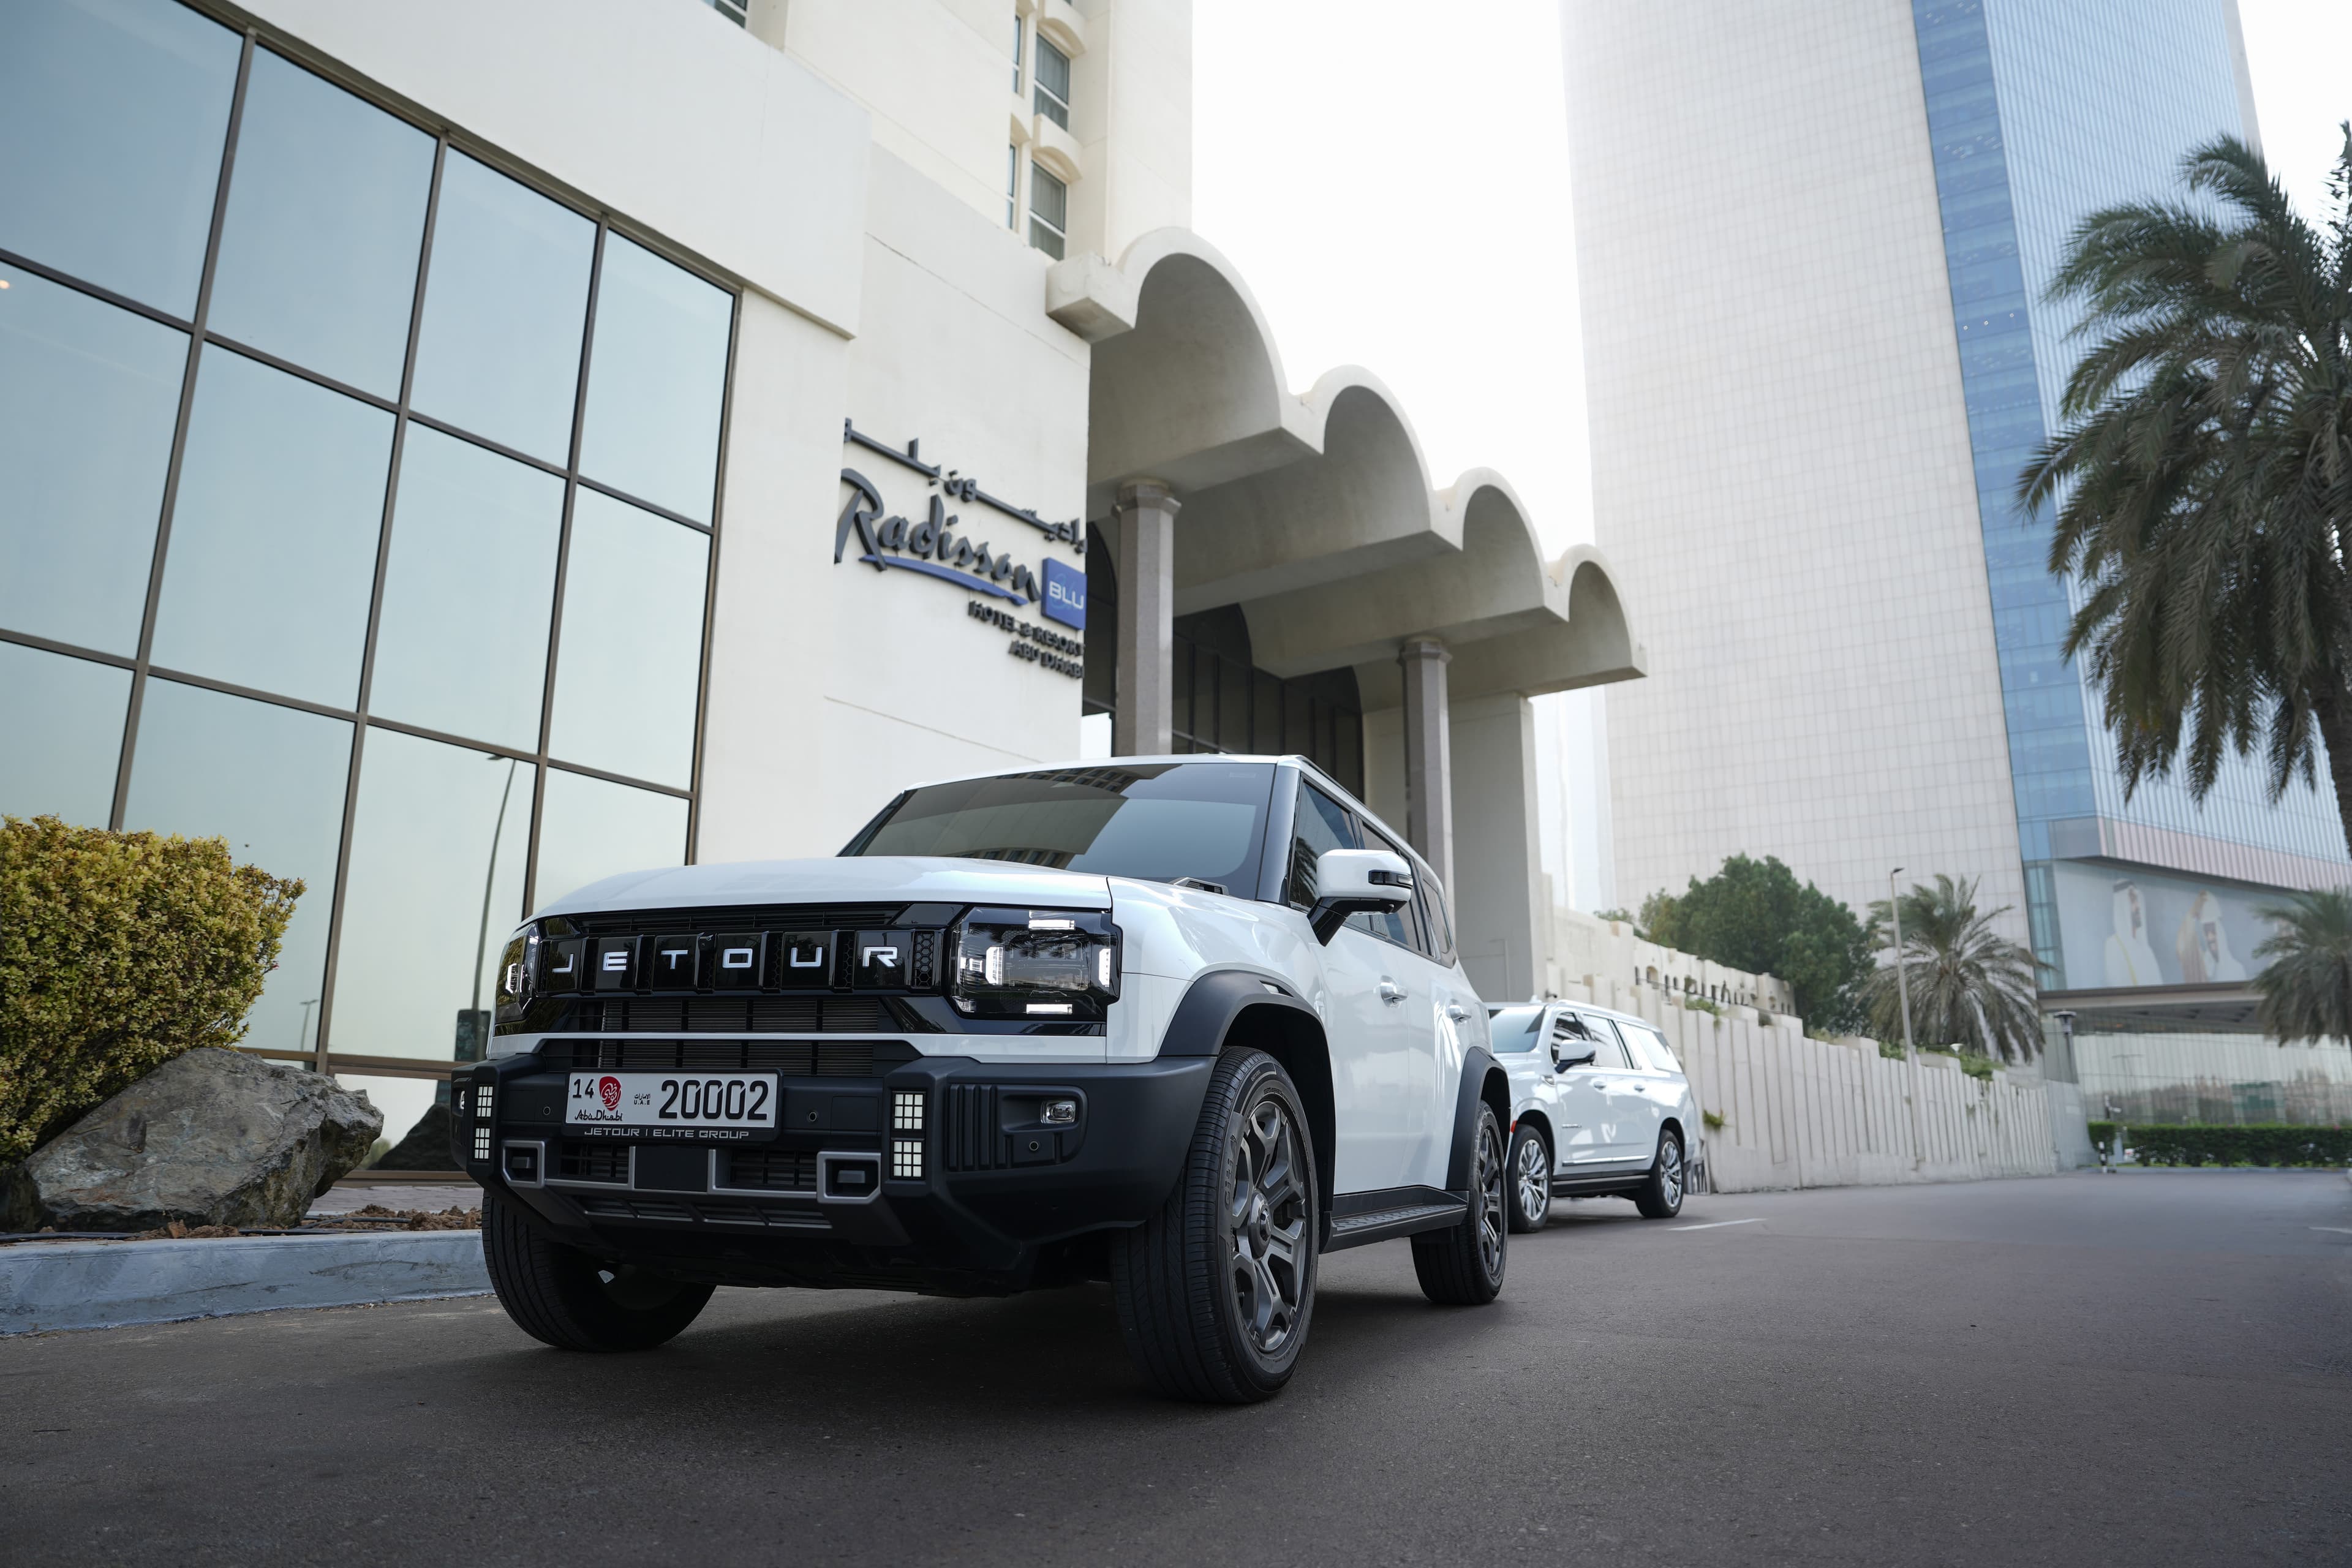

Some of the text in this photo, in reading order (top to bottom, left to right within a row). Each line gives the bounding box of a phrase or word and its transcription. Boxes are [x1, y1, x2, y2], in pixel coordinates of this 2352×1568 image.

[834, 468, 1041, 602] Radisson
[1049, 581, 1084, 609] BLU
[968, 600, 1019, 632] HOTEL
[1020, 622, 1033, 637] &
[1009, 639, 1085, 679] ABU DHABI
[552, 945, 899, 973] JETOUR
[572, 1078, 595, 1099] 14
[658, 1079, 769, 1121] 20002
[584, 1128, 749, 1139] JETOUR ELITE GROUP
